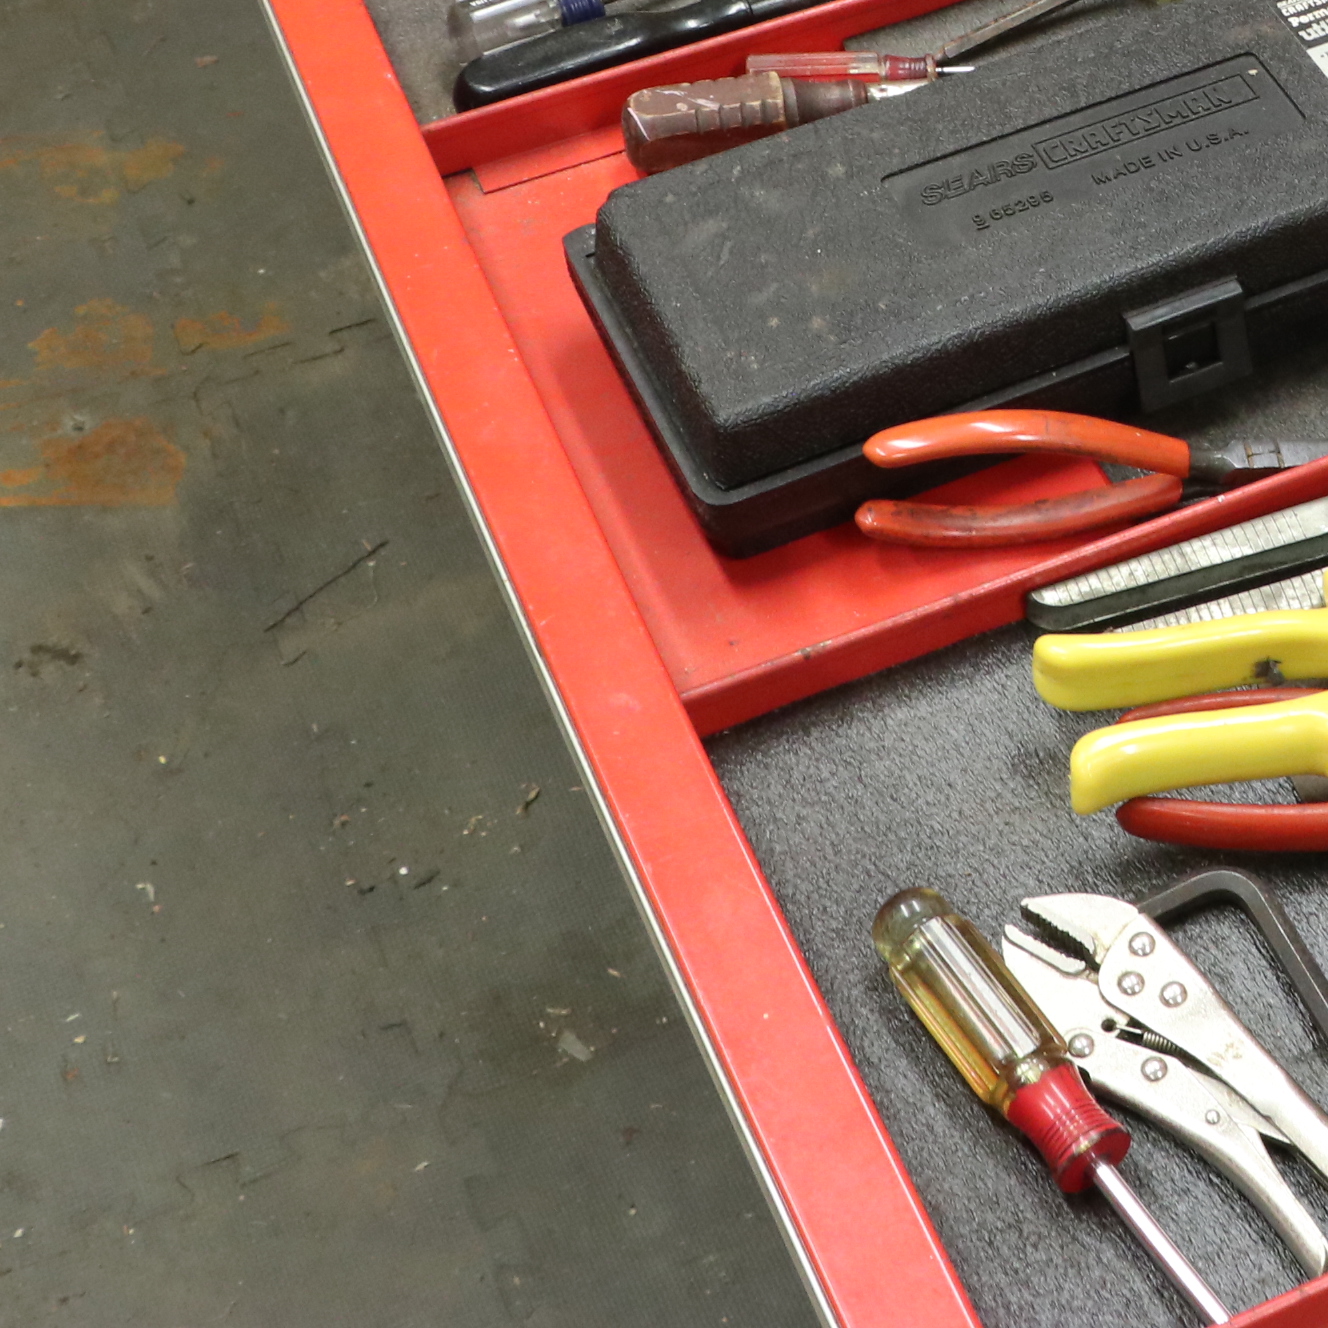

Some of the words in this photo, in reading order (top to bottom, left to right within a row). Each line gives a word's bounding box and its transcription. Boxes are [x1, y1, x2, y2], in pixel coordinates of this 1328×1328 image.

[921, 152, 1039, 207] SEARS
[1042, 86, 1233, 164] CRAFTSMAN
[1091, 155, 1156, 186] MADE
[1157, 146, 1184, 163] IN
[1185, 127, 1250, 154] U.S.A.
